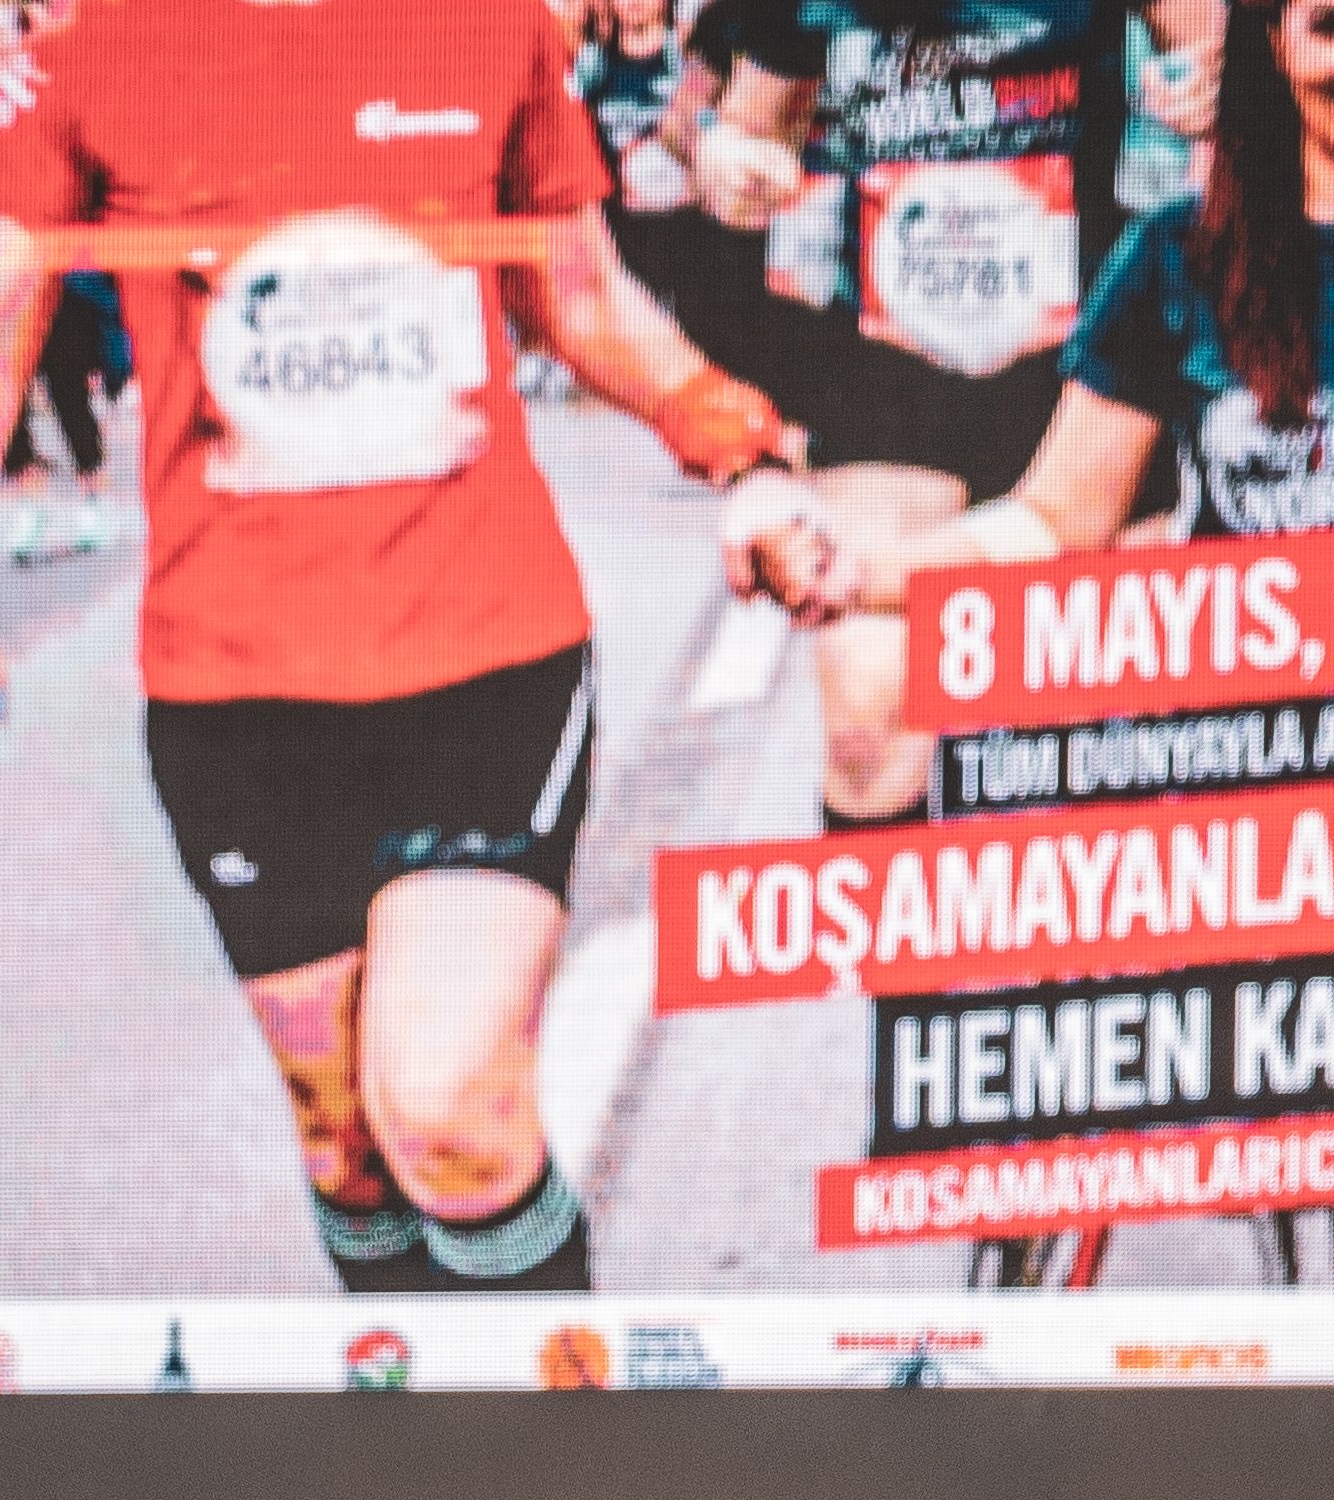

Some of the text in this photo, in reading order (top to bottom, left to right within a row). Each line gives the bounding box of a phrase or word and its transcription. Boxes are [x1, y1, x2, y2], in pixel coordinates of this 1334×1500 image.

[235, 322, 435, 394] 46843
[939, 587, 995, 701] 8
[1024, 556, 1327, 694] MAYIS,
[954, 726, 1059, 804] TÜM
[1066, 705, 1306, 795] DÜNYAYLA
[893, 987, 1212, 1131] HEMEN
